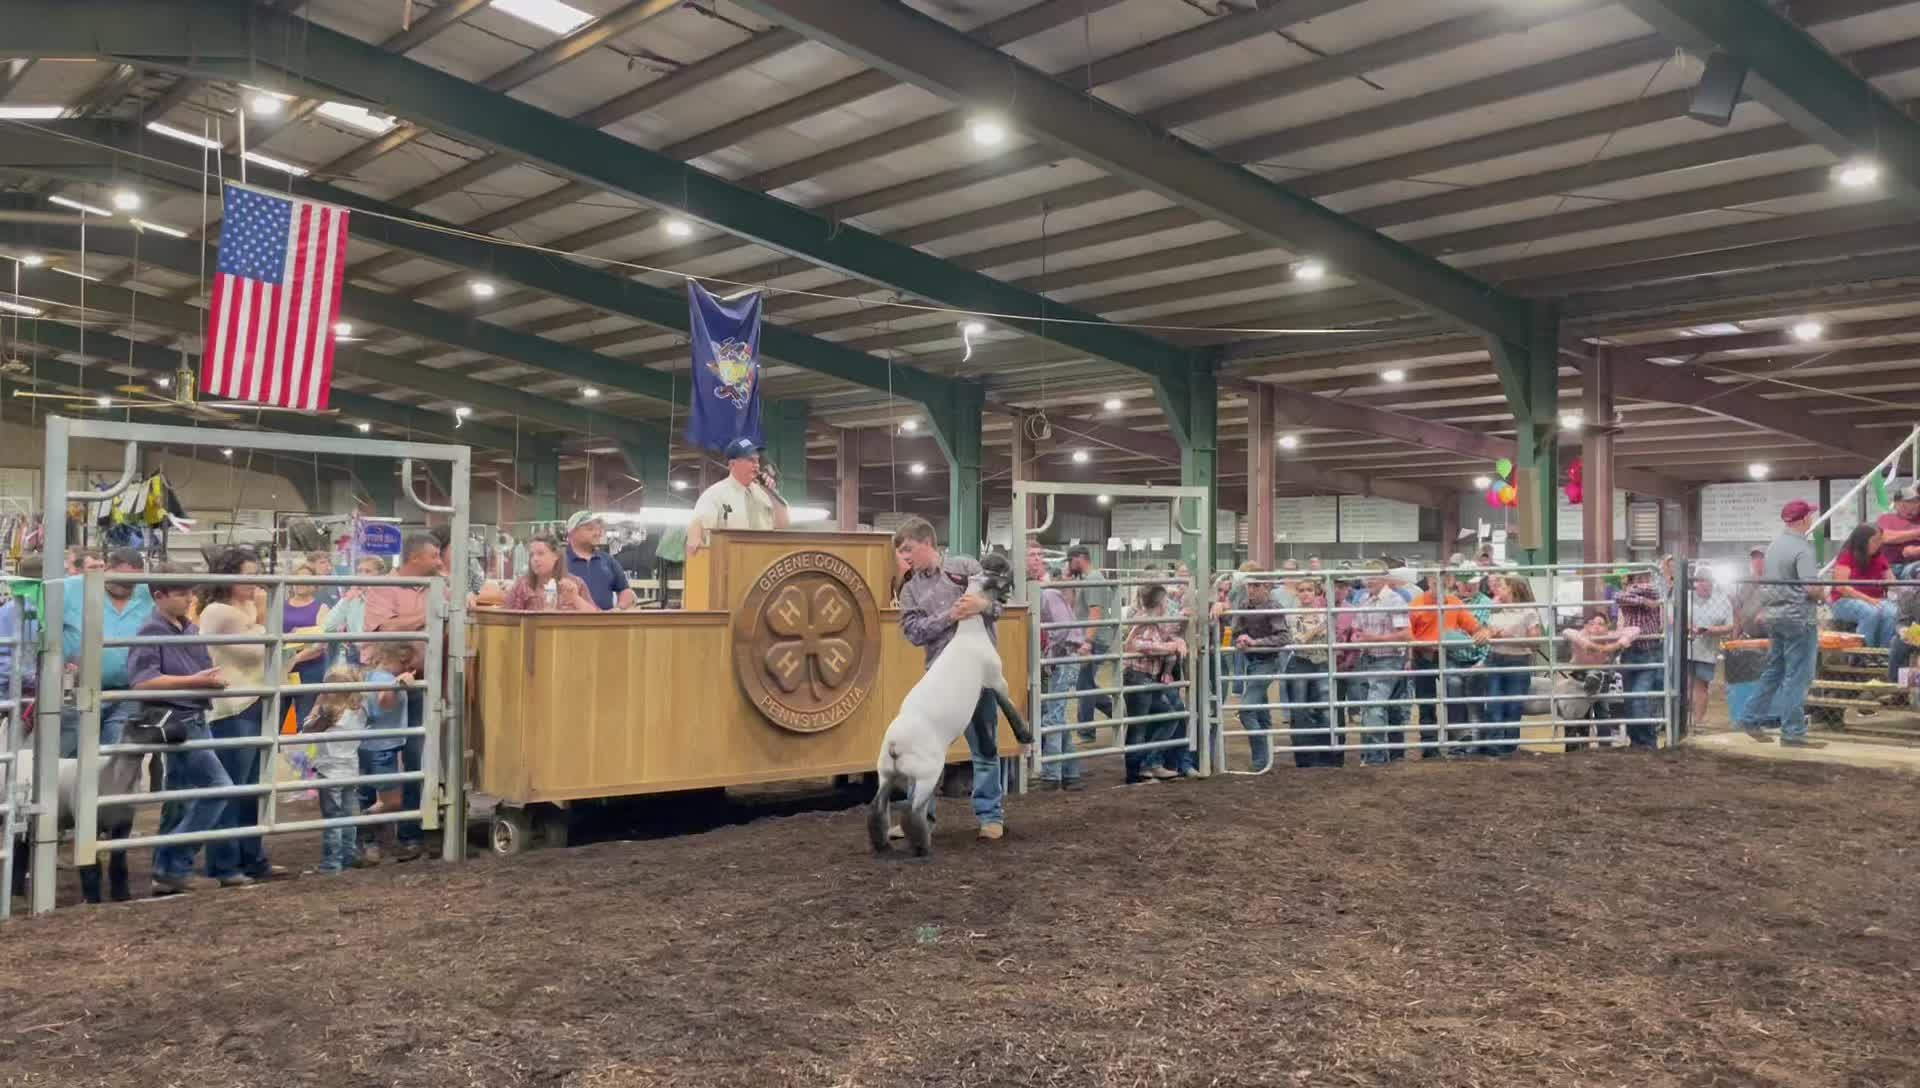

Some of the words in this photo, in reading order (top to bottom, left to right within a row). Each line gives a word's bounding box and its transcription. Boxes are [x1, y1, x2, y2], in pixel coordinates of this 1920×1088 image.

[759, 553, 811, 591] GREENE
[814, 554, 865, 592] COUNTY
[778, 600, 800, 626] H
[821, 598, 843, 624] H
[776, 651, 799, 678] H
[824, 647, 846, 673] H
[760, 687, 864, 727] PENNSYLVANIA
